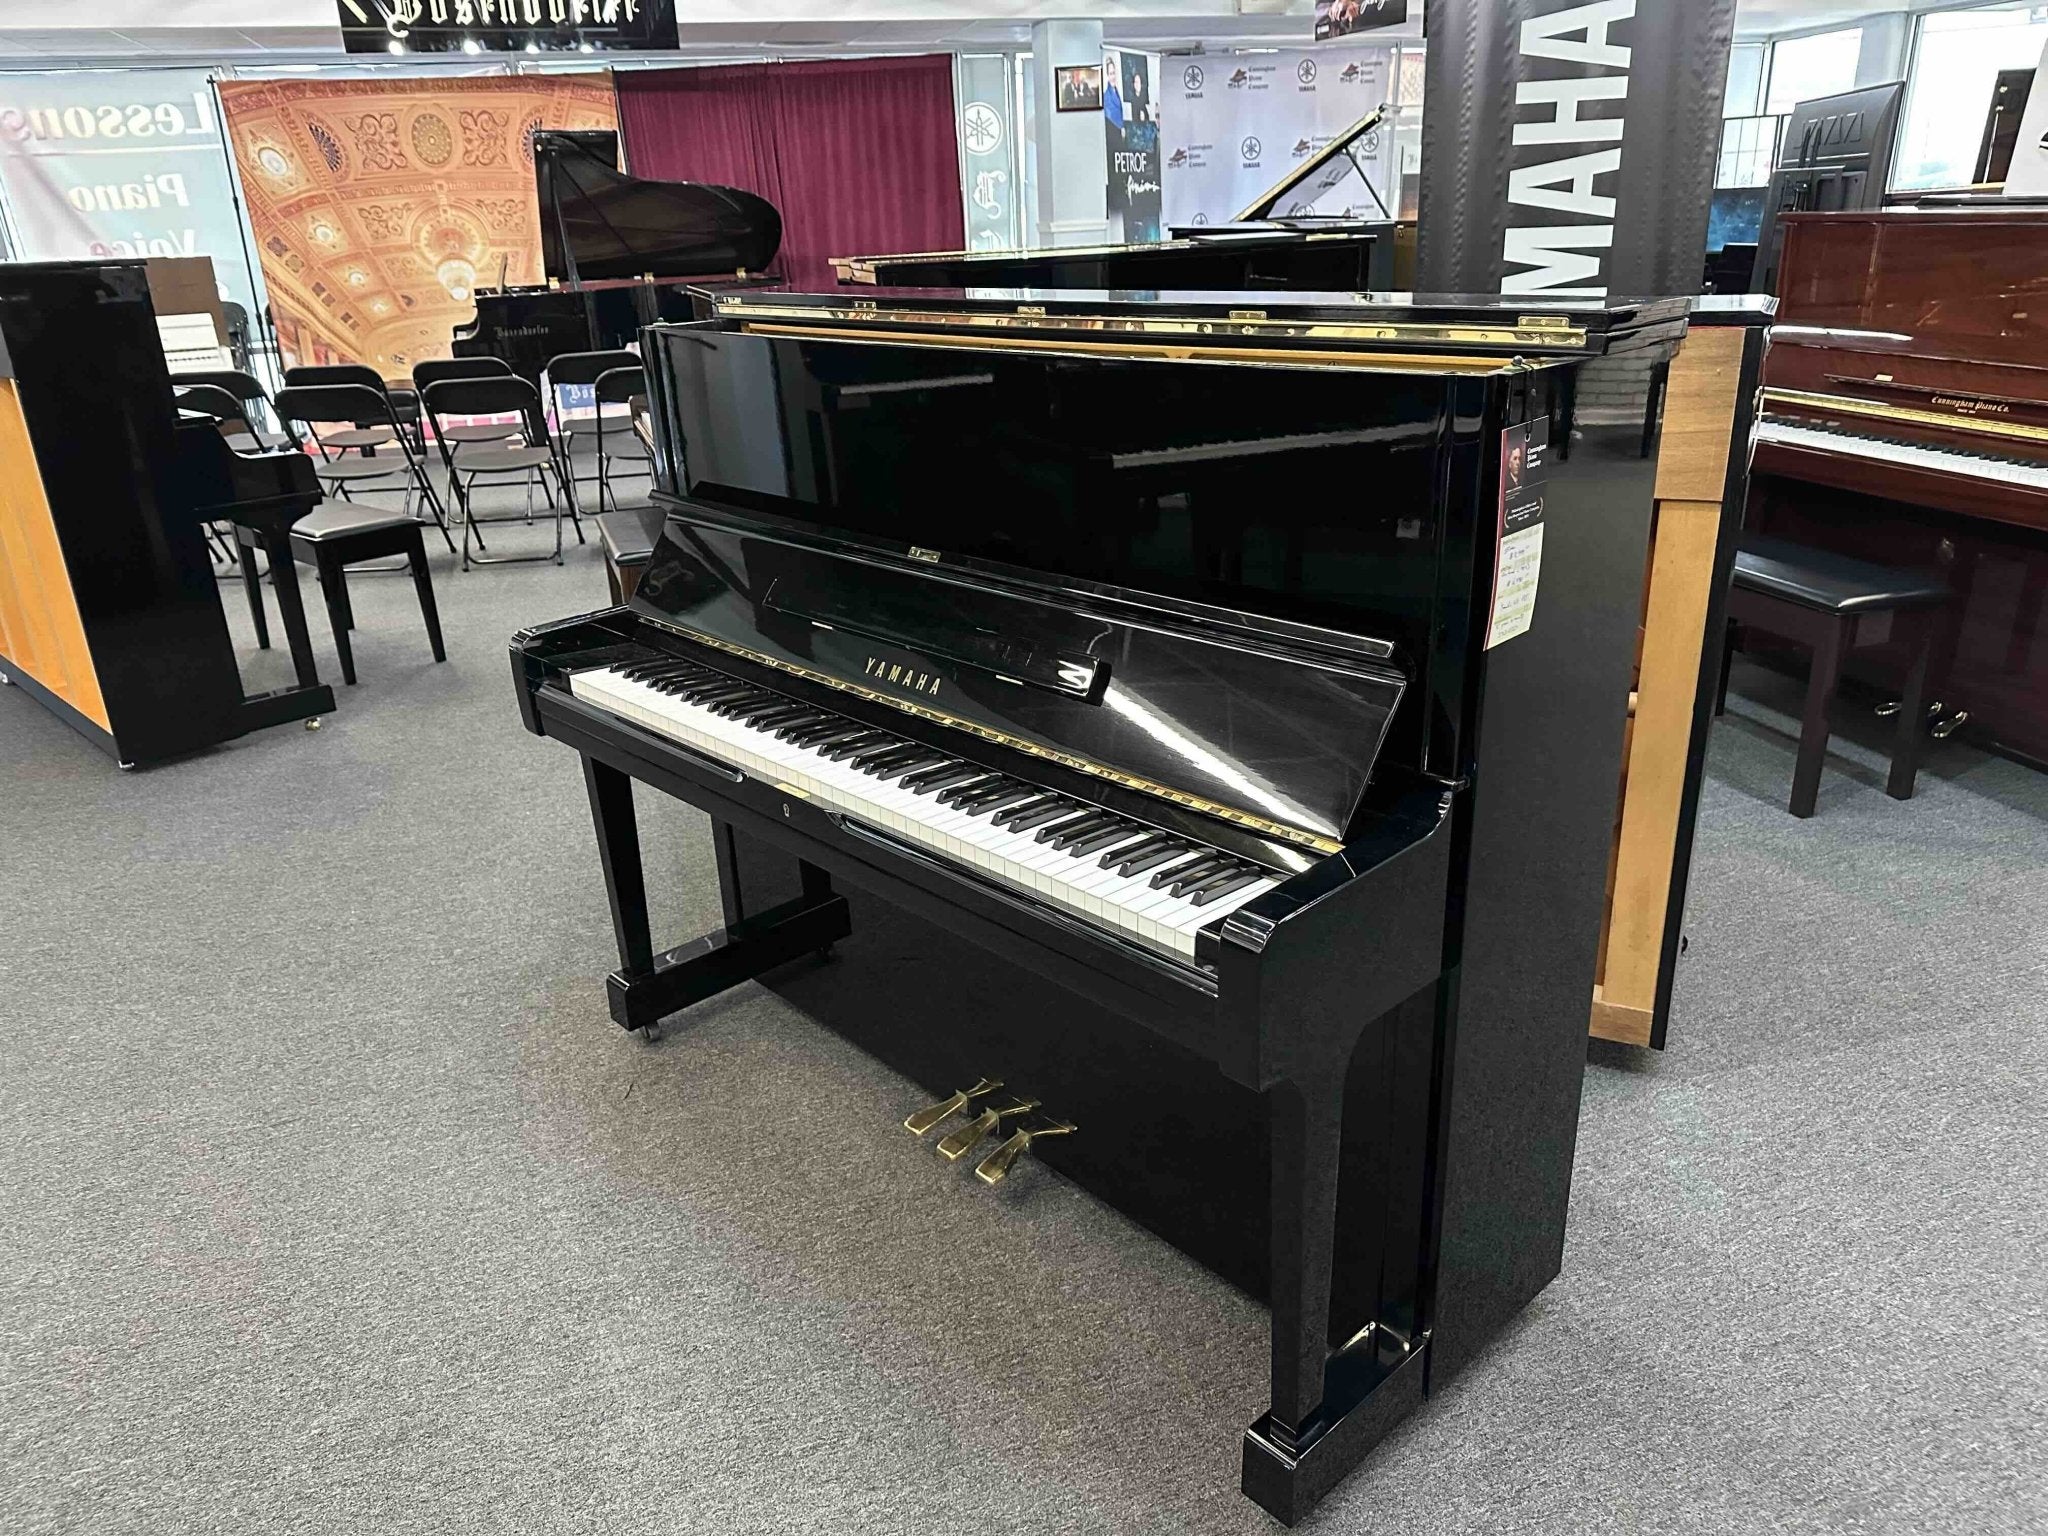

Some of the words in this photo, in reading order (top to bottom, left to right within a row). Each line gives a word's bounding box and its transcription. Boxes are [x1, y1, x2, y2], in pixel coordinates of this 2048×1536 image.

[1114, 152, 1147, 173] PETROF
[1931, 396, 1975, 408] Cunningham
[1975, 401, 1997, 411] Piano
[863, 656, 942, 696] YAMAHA
